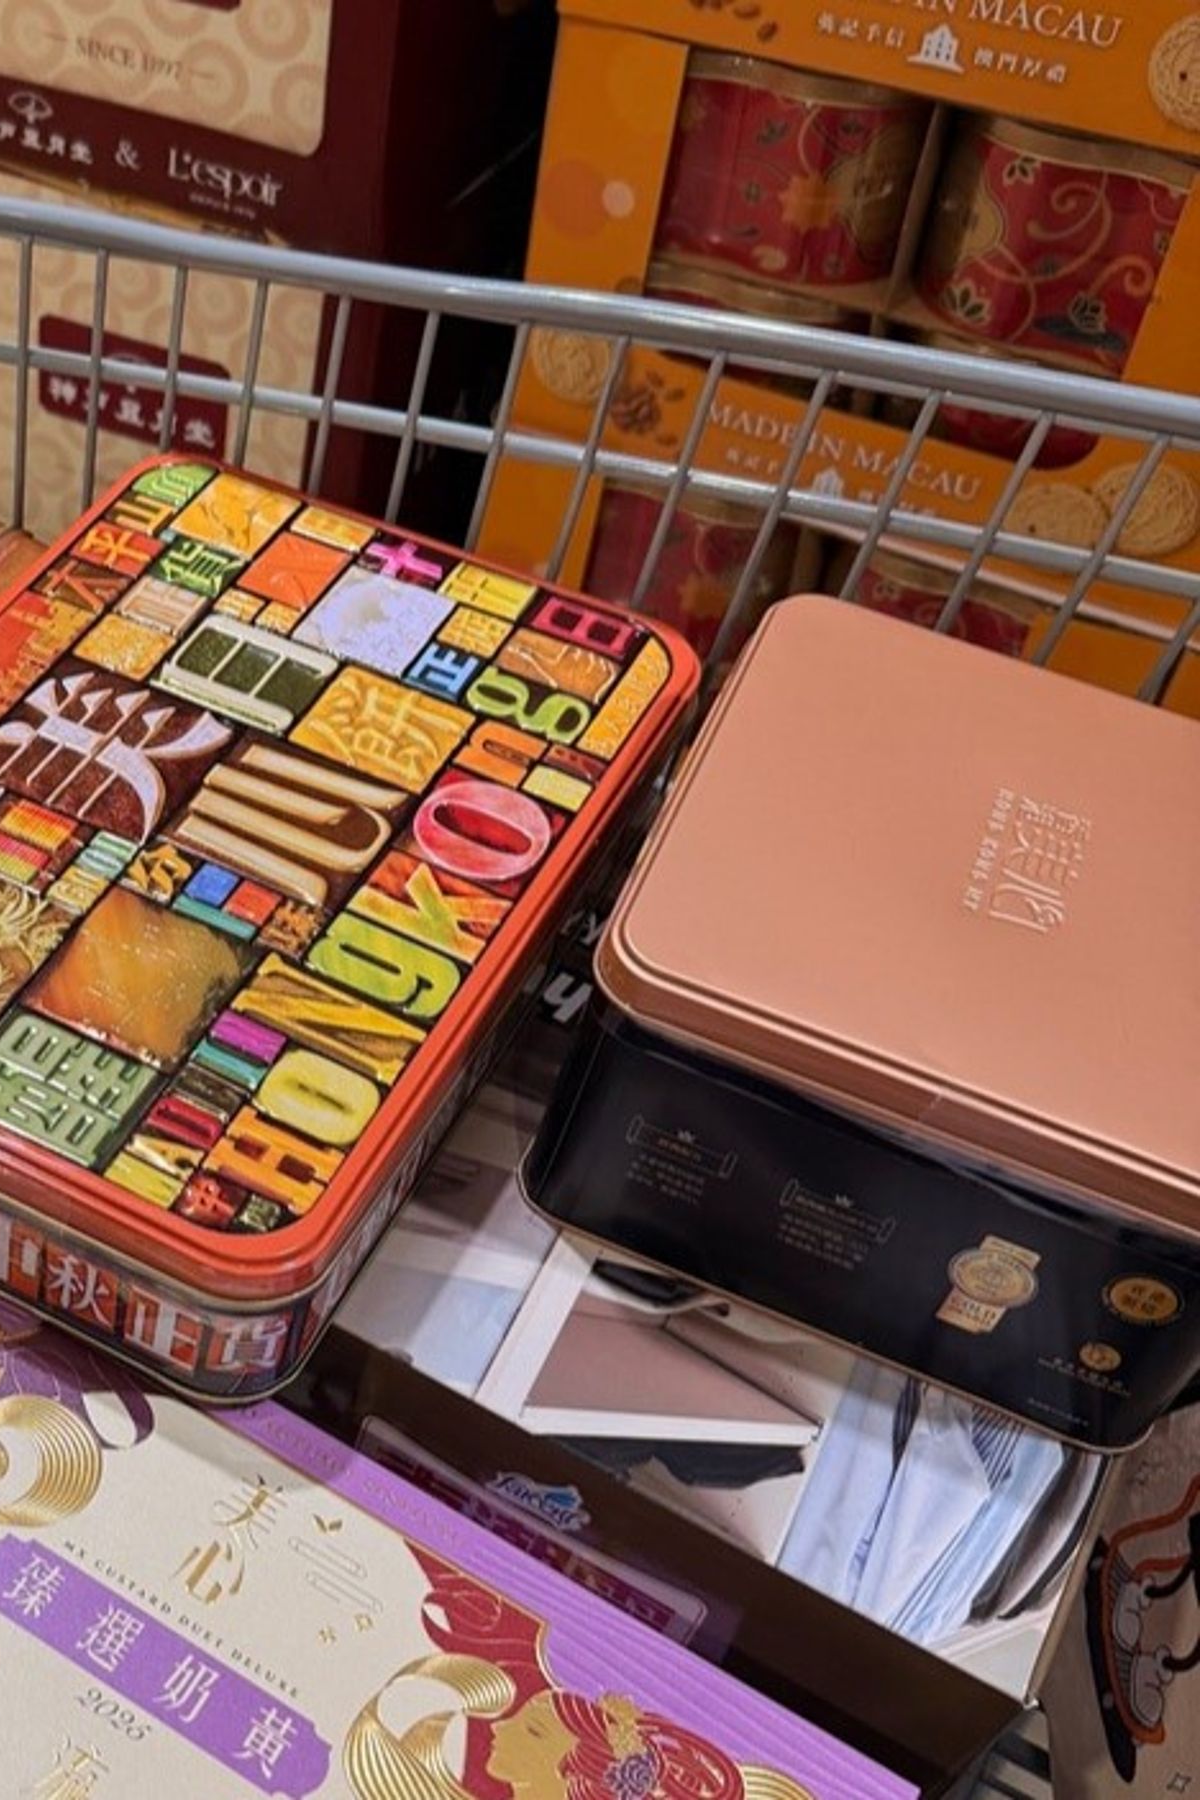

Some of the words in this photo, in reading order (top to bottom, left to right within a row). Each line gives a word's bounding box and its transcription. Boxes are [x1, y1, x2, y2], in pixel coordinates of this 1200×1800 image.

[968, 0, 1123, 47] MACAU
[115, 139, 141, 171] &
[94, 1559, 174, 1615] CUSTARD
[178, 1614, 223, 1649] DUET
[231, 1648, 301, 1700] DELUXE
[2, 1551, 299, 1780] 臻選奶黃
[72, 1686, 158, 1743] 2025
